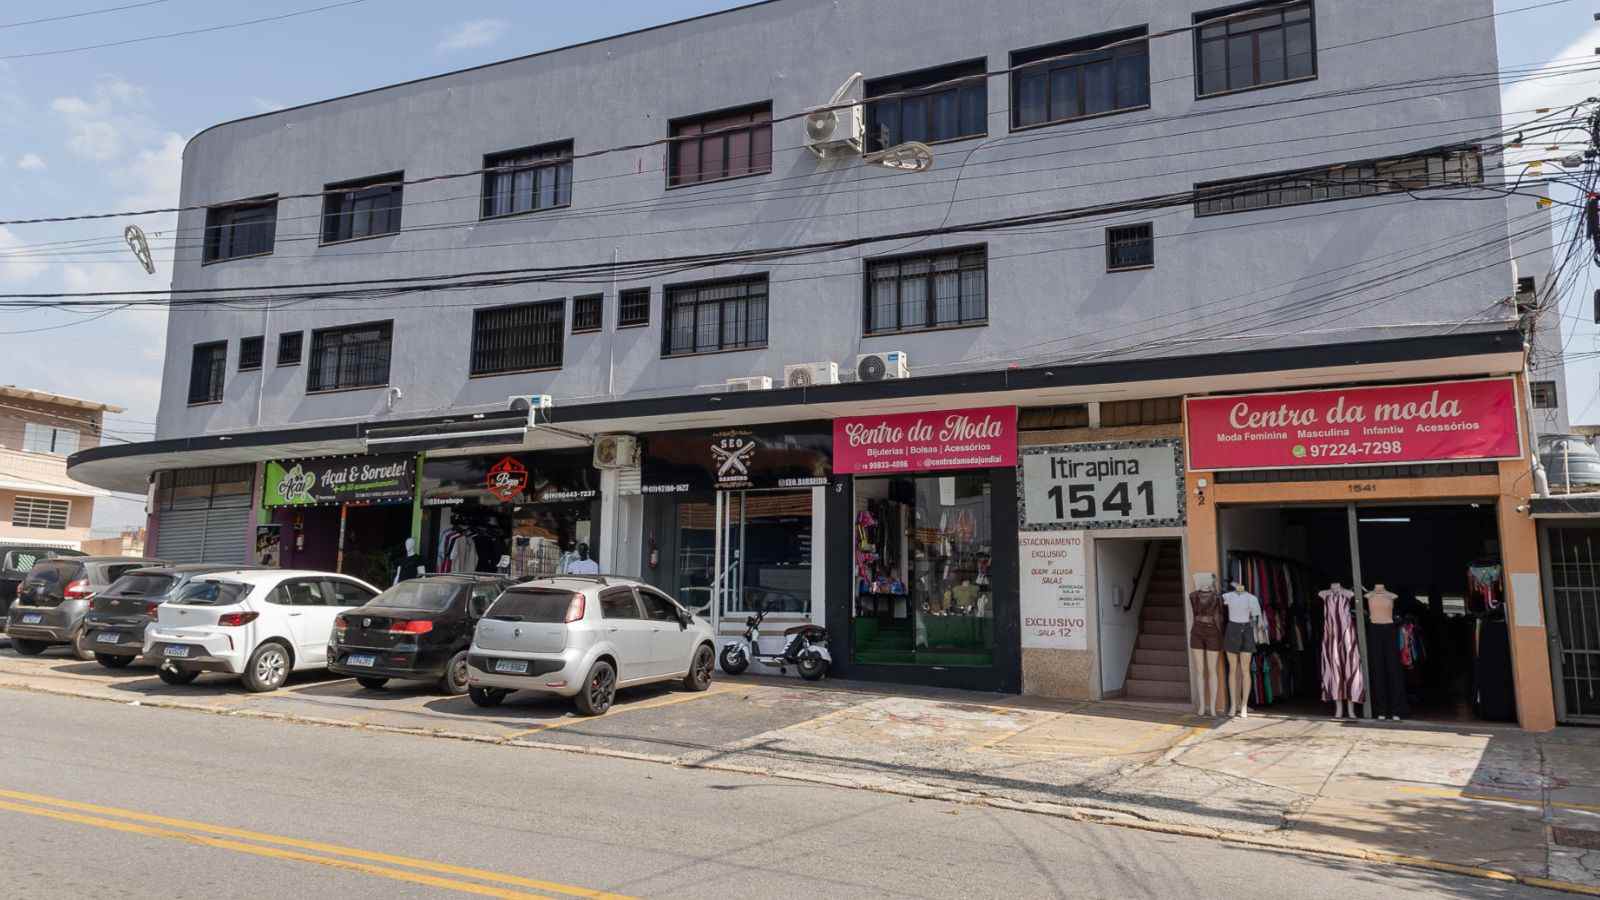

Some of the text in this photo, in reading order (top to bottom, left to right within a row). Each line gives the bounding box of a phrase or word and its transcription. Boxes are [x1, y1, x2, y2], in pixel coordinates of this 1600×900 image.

[1229, 390, 1462, 429] Centro da moda
[845, 414, 1003, 447] Centro da Moda
[1217, 433, 1242, 442] Moda
[1244, 431, 1288, 441] Feminina
[1297, 428, 1350, 439] Masculina
[1416, 421, 1480, 433] Acessórios
[721, 438, 743, 448] SEO
[867, 443, 991, 458] Bijuterias Bolsas Acessórios
[1310, 440, 1402, 457] 97224-7298
[349, 465, 360, 482] &
[361, 461, 407, 481] Sorvete!
[1051, 456, 1140, 481] Itirapina
[1349, 484, 1376, 493] 1541
[1048, 480, 1154, 519] 1541
[1198, 495, 1205, 506] 2
[1031, 550, 1068, 559] EXCLUSIVO
[1024, 617, 1085, 628] EXCLUSIVO
[1058, 628, 1072, 638] 12
